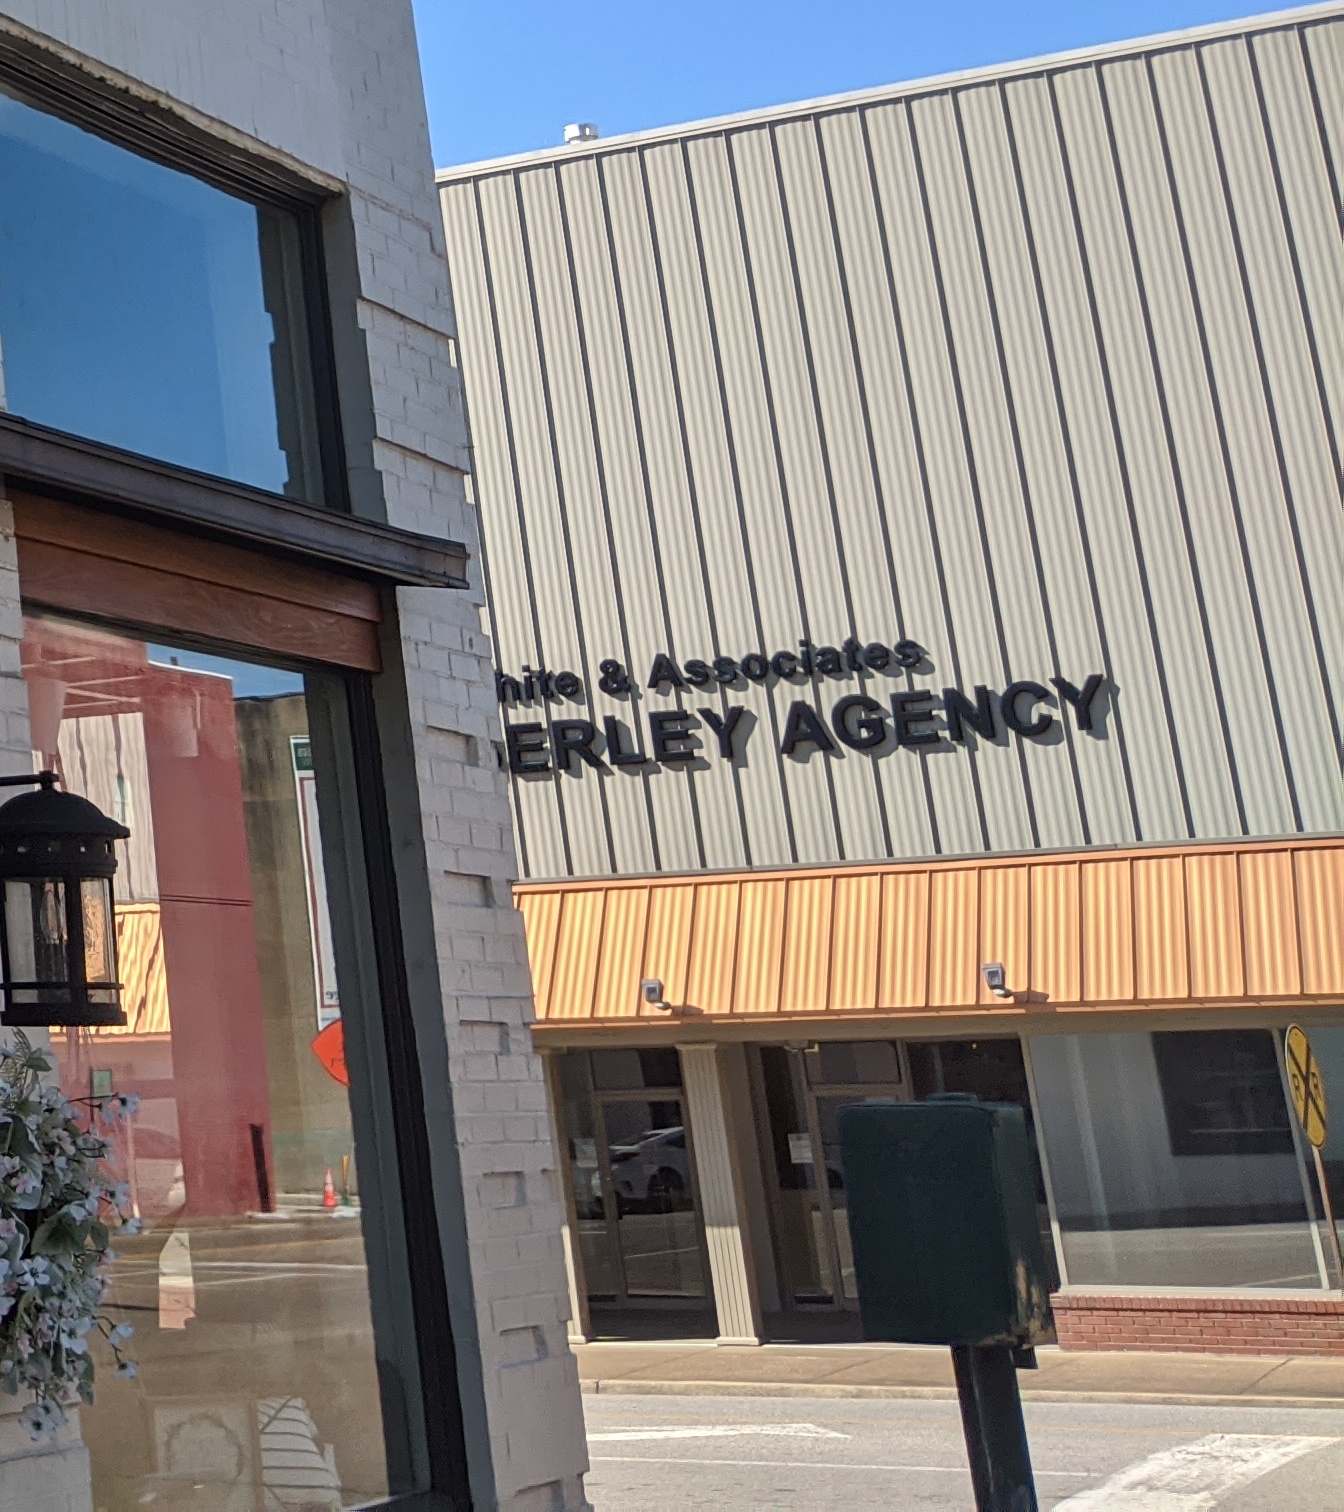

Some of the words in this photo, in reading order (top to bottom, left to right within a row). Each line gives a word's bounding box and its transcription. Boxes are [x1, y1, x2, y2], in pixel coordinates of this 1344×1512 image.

[598, 658, 631, 695] &
[648, 637, 922, 690] Associates
[496, 706, 745, 774] ERLEY
[780, 673, 1104, 756] AGENCY
